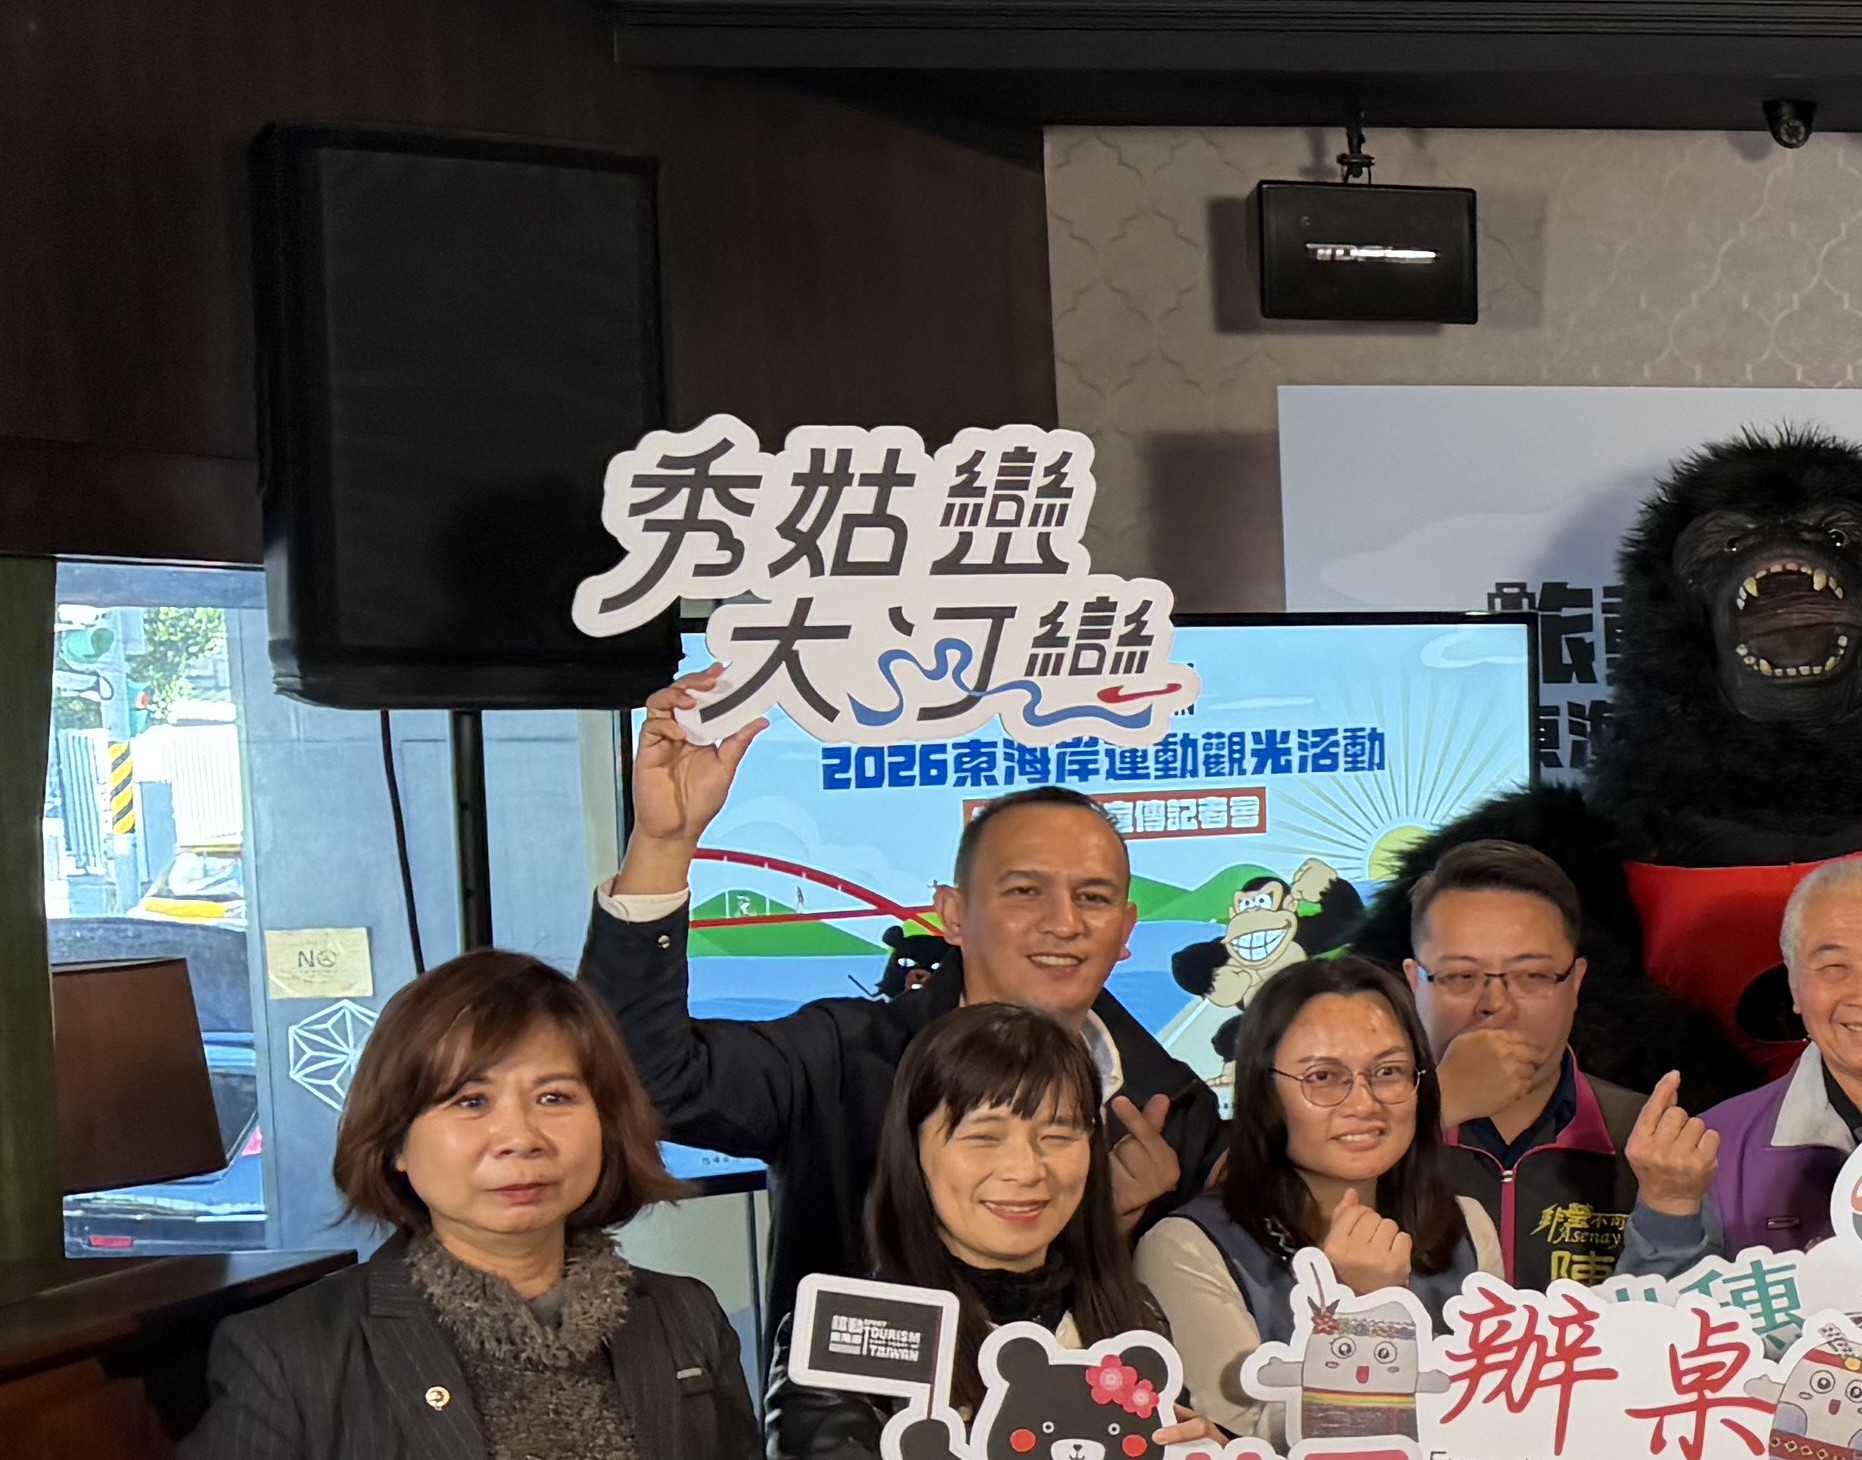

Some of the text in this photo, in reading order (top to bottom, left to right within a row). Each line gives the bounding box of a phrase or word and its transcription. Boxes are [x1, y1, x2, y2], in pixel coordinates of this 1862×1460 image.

[599, 437, 1077, 613] 秀姑巒
[1487, 581, 1625, 687] 旅
[822, 727, 1386, 790] 2026東海岸運動觀光活動
